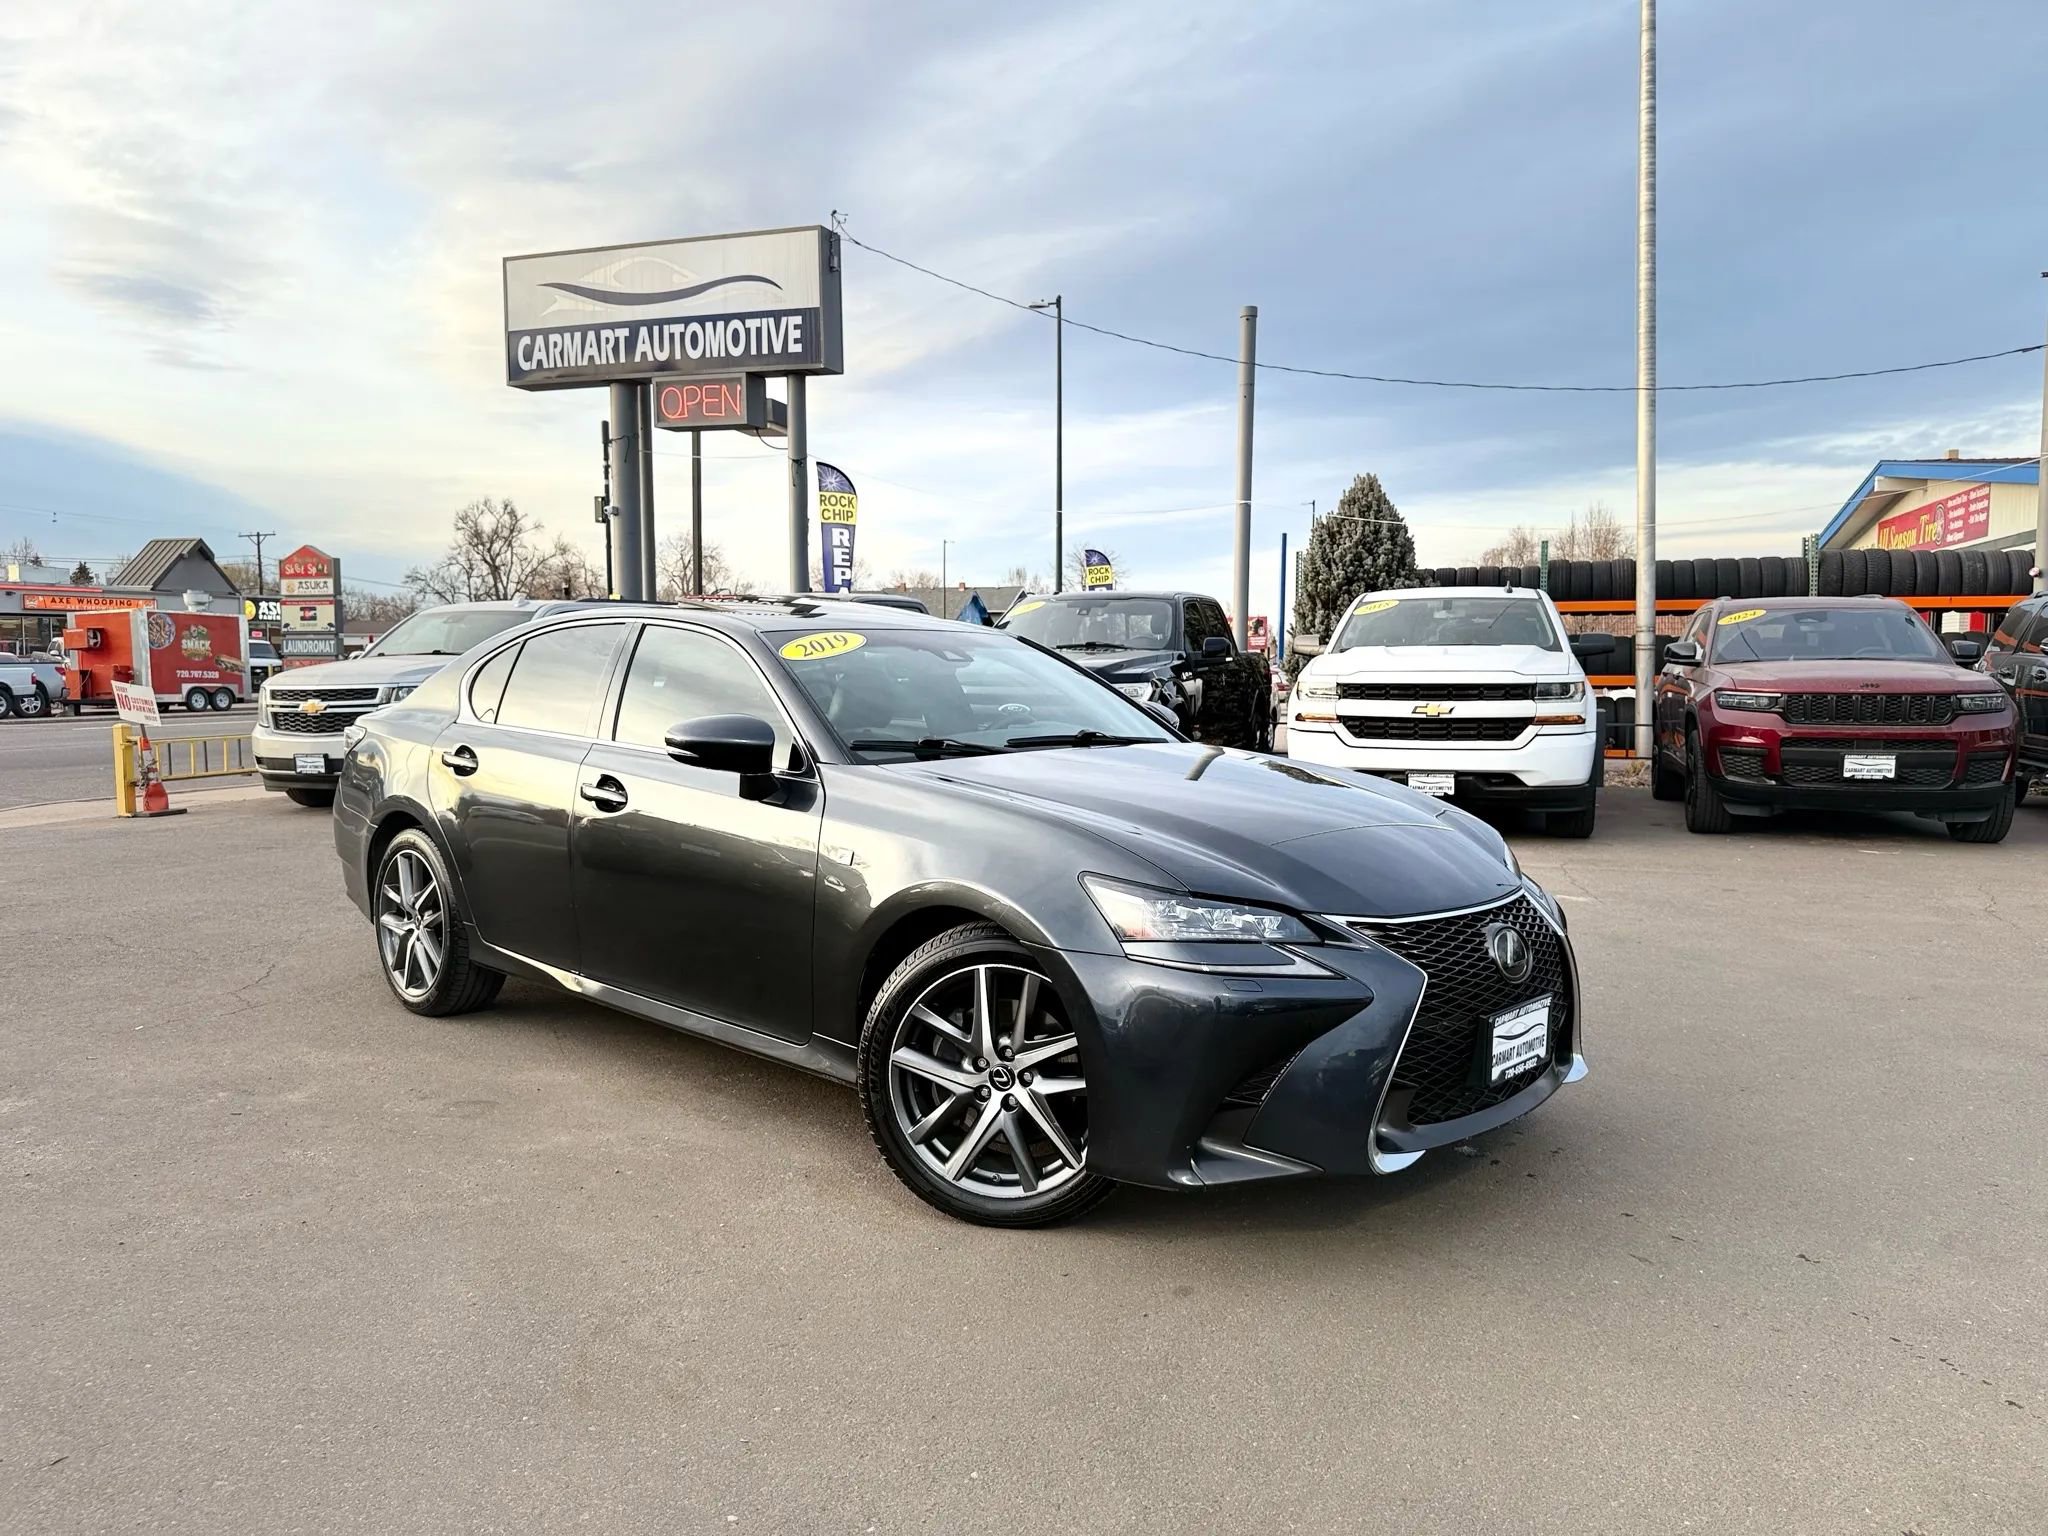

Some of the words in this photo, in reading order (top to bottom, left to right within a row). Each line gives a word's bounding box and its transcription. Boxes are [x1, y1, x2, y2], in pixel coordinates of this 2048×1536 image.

[517, 327, 630, 371] CARMART
[634, 315, 803, 363] AUTOMOTIVE
[660, 384, 741, 419] OPEN
[819, 494, 855, 509] ROCK
[821, 508, 854, 522] CHIP
[1890, 526, 1918, 549] Season
[1088, 566, 1110, 576] ROCK
[297, 581, 329, 590] ASUKA
[1090, 575, 1110, 584] CHIP
[77, 598, 132, 607] WHOOPING
[181, 639, 212, 651] SMACK
[283, 640, 335, 653] LAUNDROMAT
[795, 634, 849, 657] 2019
[117, 692, 131, 711] NO
[132, 705, 156, 714] PARKING
[1491, 1046, 1515, 1067] CARMART
[1516, 1034, 1545, 1058] AUTOMOTIVE
